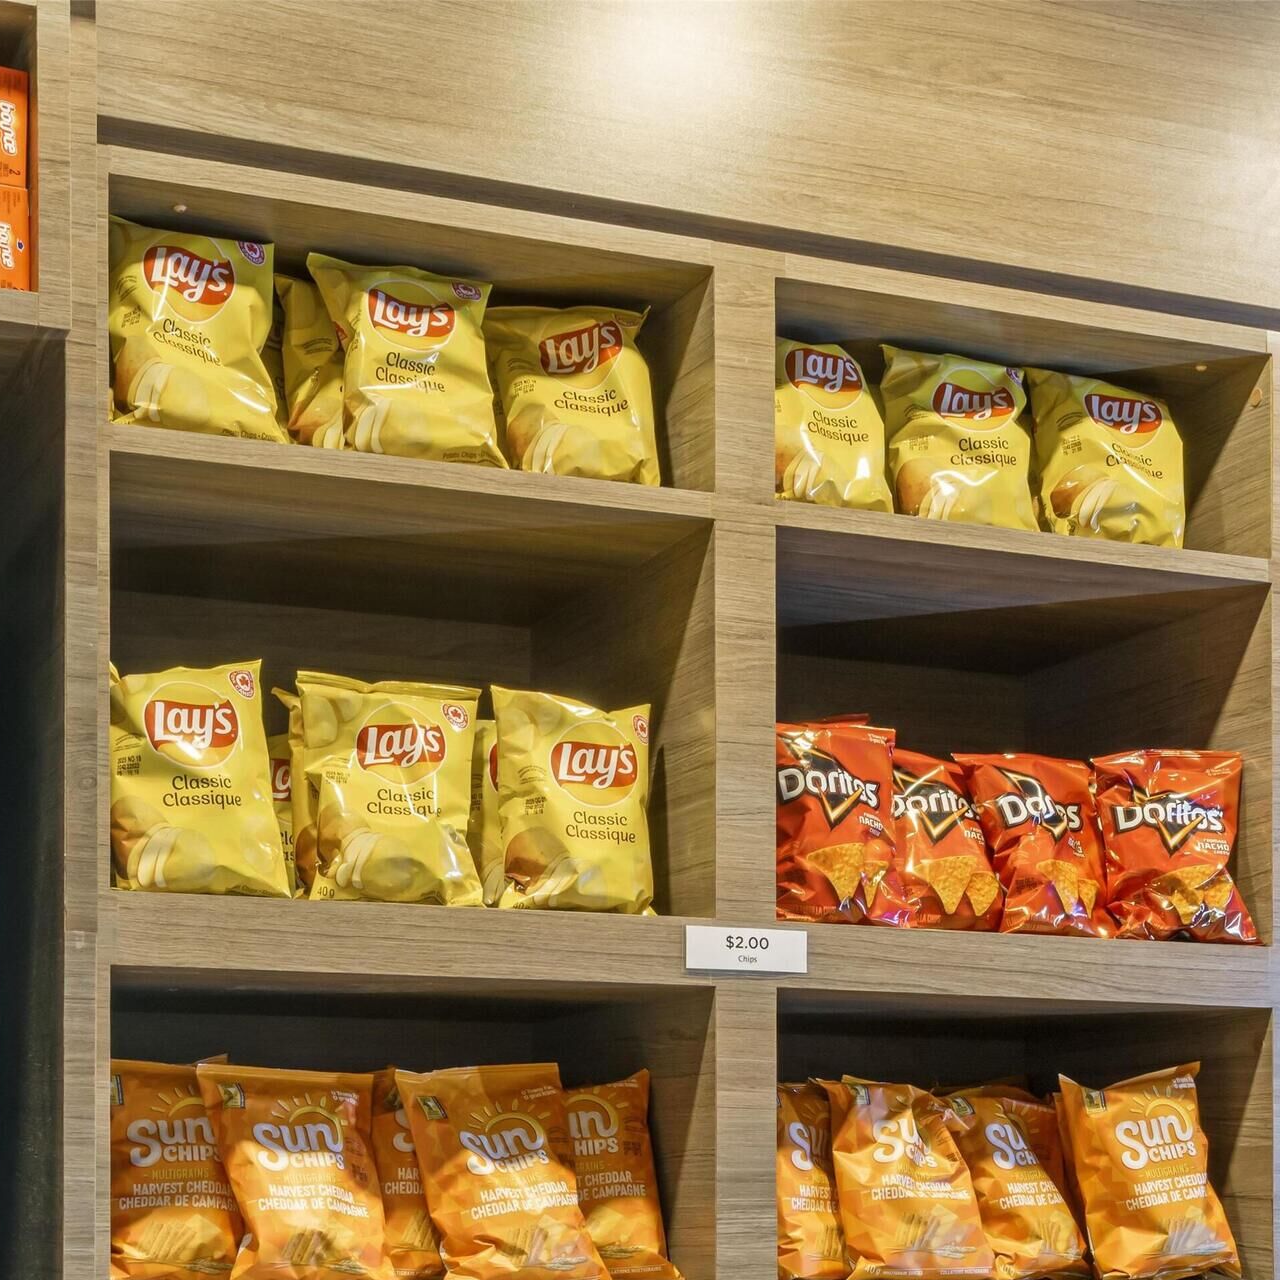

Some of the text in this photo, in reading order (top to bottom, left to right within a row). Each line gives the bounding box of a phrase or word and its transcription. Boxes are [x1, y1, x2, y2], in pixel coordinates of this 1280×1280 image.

[151, 247, 229, 302] Lay's
[373, 291, 449, 337] Lay's
[163, 318, 211, 349] Classic
[153, 331, 220, 366] Classique
[545, 322, 616, 374] Lay's
[386, 351, 435, 376] Classic
[795, 351, 859, 394] Lay's
[563, 388, 617, 404] Classic
[941, 382, 1011, 421] Lay's
[554, 399, 629, 416] Classique
[1090, 395, 1157, 435] Lay's
[812, 409, 858, 429] Classic
[807, 421, 870, 445] Classique
[958, 437, 1009, 452] Classic
[950, 451, 1017, 468] Classique
[153, 701, 232, 749] Lay's
[365, 726, 442, 767] Lay's
[558, 743, 634, 789] Lay's
[172, 774, 232, 790] Classic
[778, 768, 879, 808] Doritos
[162, 790, 242, 810] Classique
[377, 787, 435, 802] Classic
[573, 811, 628, 826] Classic
[1113, 800, 1224, 832] Doritos
[566, 825, 636, 845] Classique
[726, 935, 769, 950] $2.00
[738, 955, 757, 963] Chips
[253, 1121, 344, 1171] Sun
[1115, 1115, 1193, 1170] Sun
[1148, 1142, 1197, 1163] CHIPS
[289, 1152, 345, 1170] CHIPS
[269, 1184, 354, 1202] HARVEST CHEDDAR
[1134, 1179, 1173, 1195] HARVEST
[258, 1199, 308, 1212] CHEDDAR
[327, 1200, 369, 1218] CAMPAGNE
[1126, 1191, 1182, 1211] CHEDDAR DE
